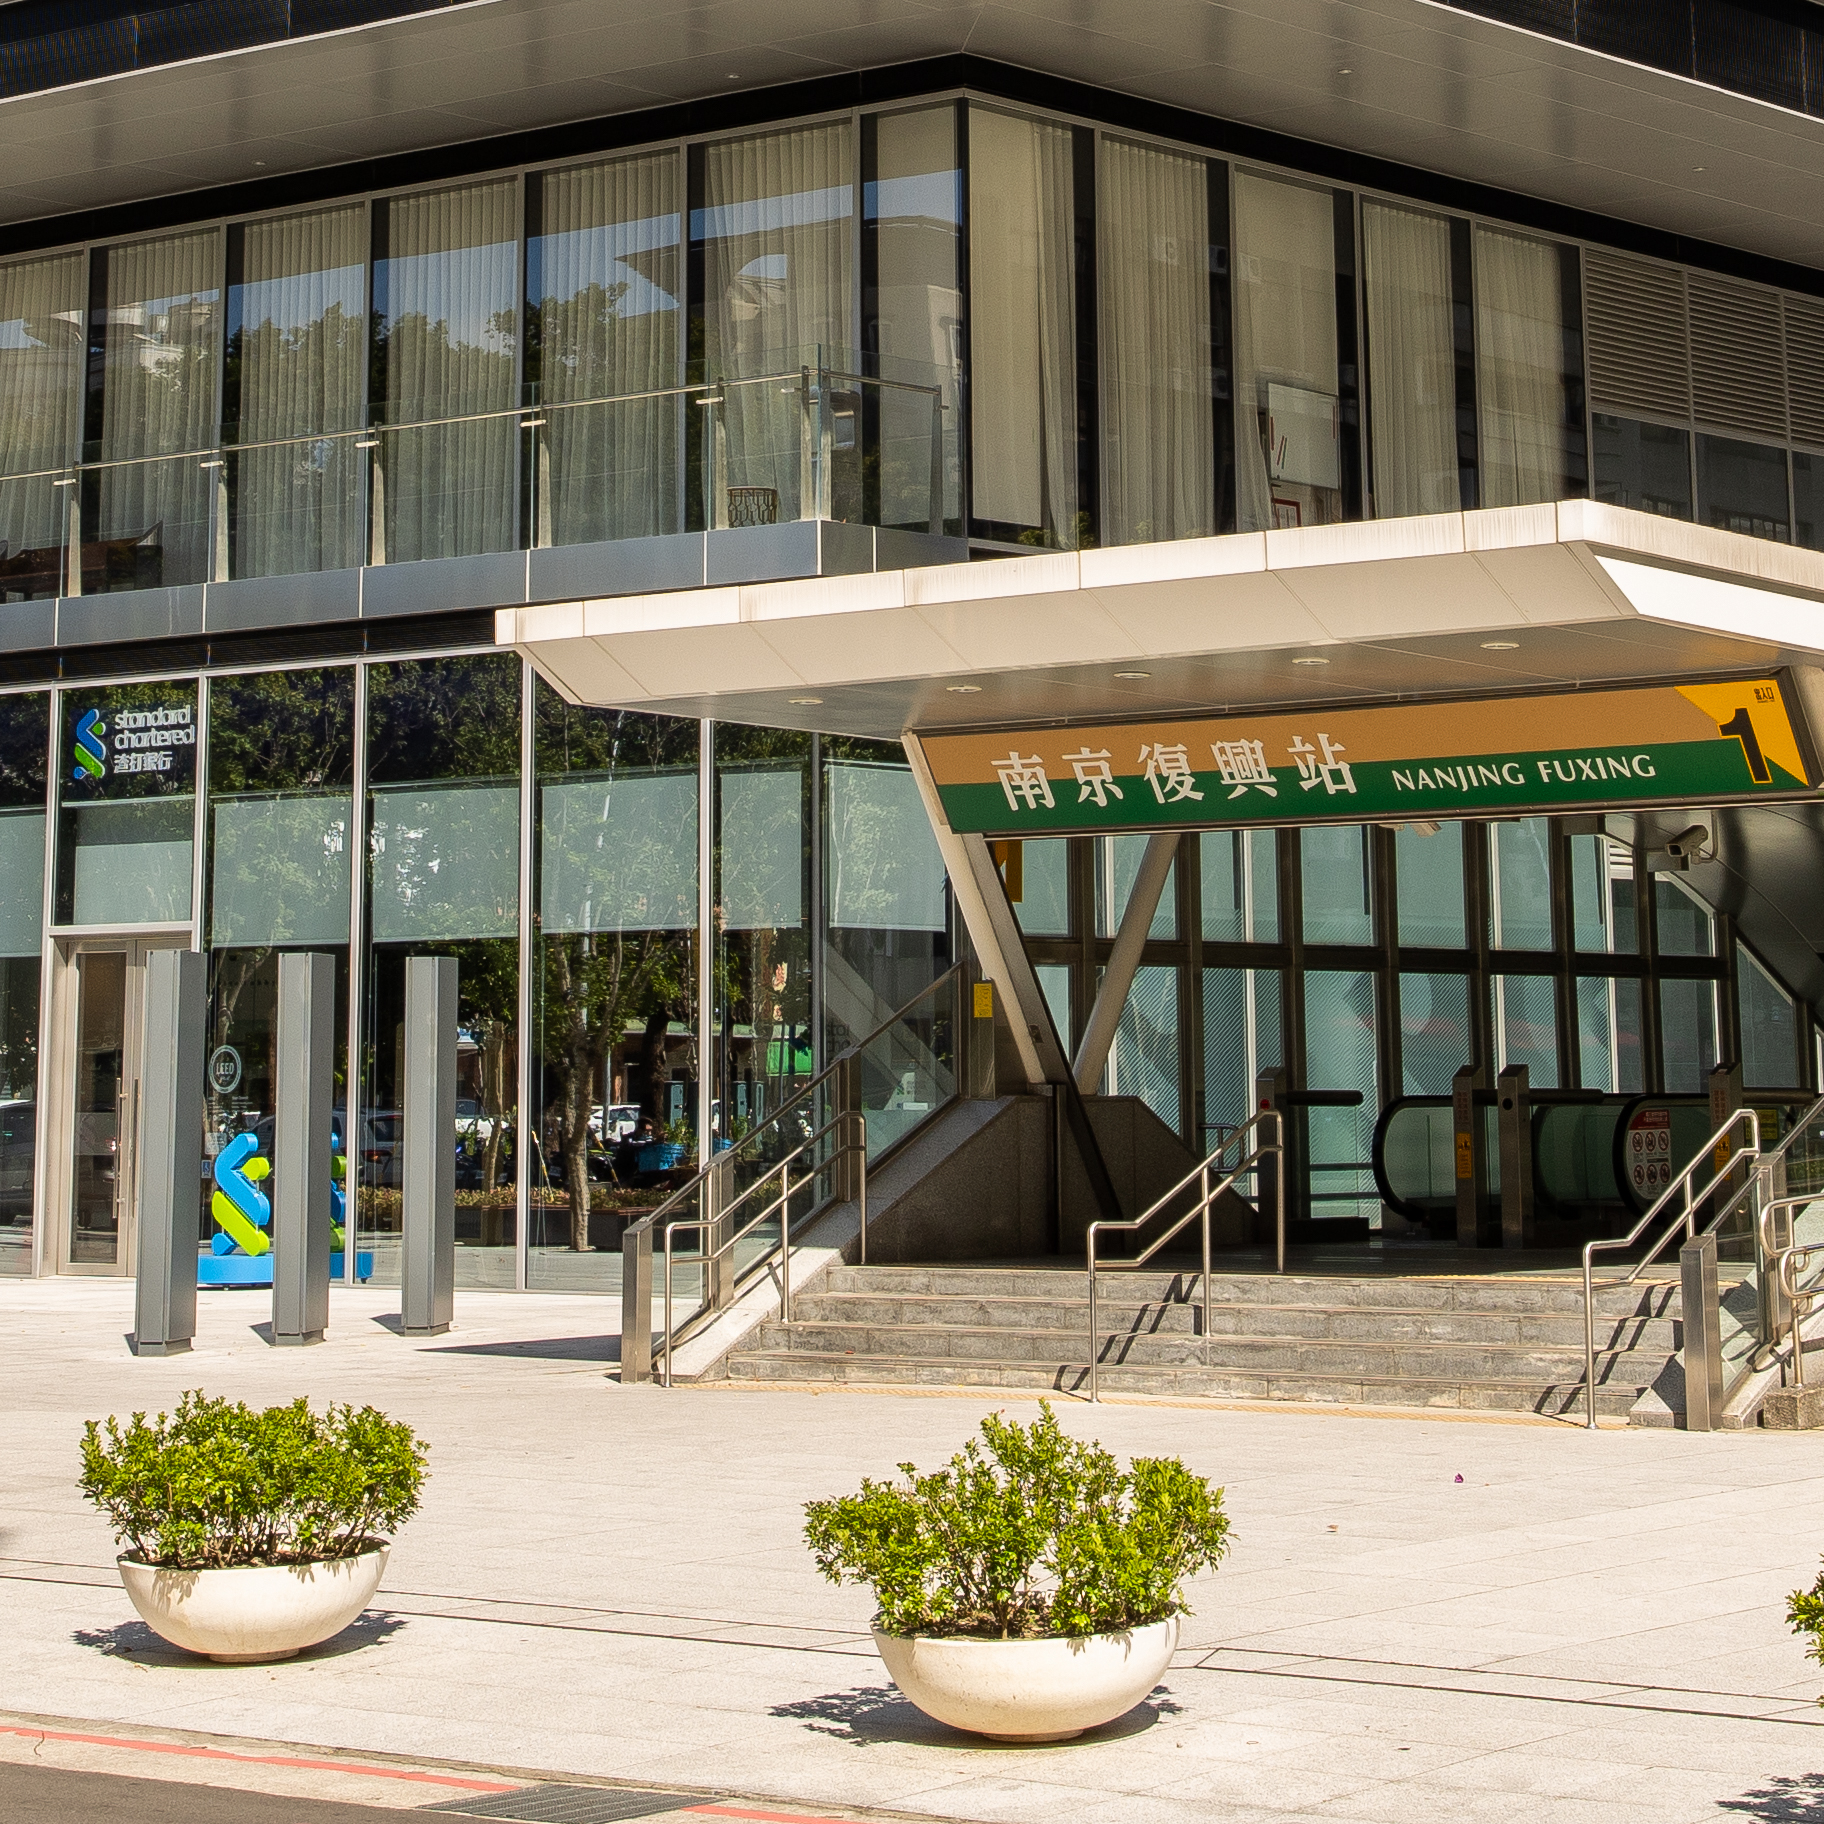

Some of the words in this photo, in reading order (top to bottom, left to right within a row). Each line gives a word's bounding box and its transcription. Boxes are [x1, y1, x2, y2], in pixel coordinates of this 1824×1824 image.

[114, 705, 191, 729] standard
[114, 724, 196, 750] chartered
[1718, 706, 1773, 785] 1
[990, 732, 1358, 813] 南京復興站
[1393, 762, 1526, 791] NANJING
[1540, 755, 1657, 785] FUXING
[216, 1062, 235, 1075] LEED
